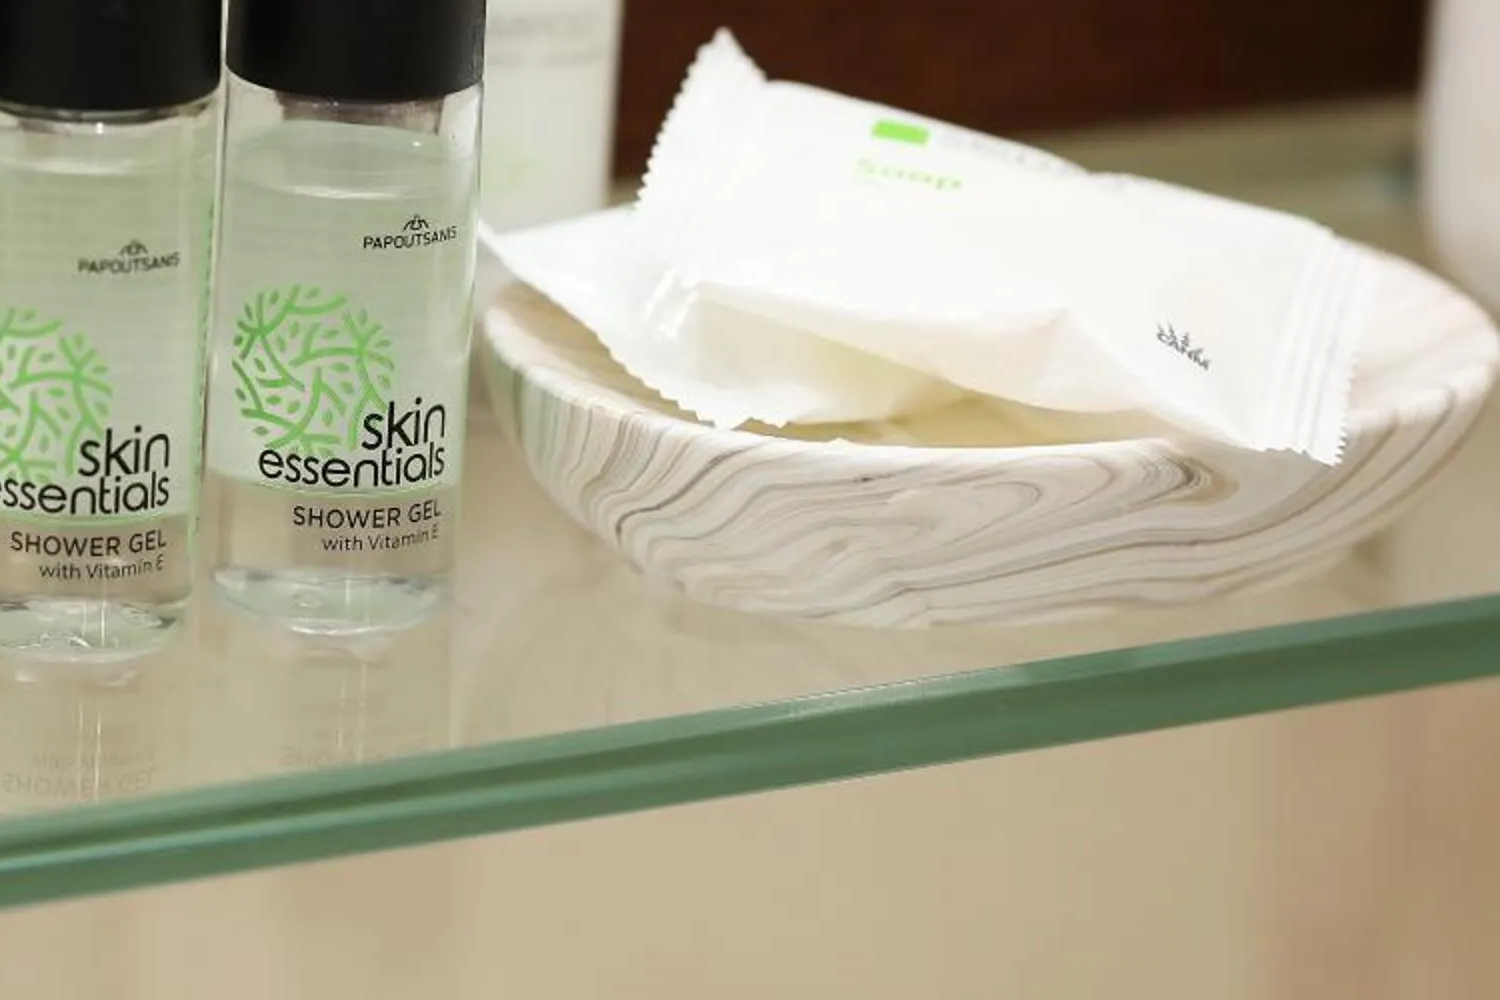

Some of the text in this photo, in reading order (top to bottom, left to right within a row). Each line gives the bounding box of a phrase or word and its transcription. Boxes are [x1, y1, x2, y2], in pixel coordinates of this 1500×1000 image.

[363, 225, 457, 249] PAPOUTSANIS
[361, 396, 446, 450] skin
[78, 425, 170, 477] skin
[258, 441, 445, 488] essentials
[292, 499, 442, 529] SHOWER GEL
[10, 528, 167, 558] SHOWER GEL
[322, 534, 363, 551] with
[367, 529, 430, 551] Vitamin
[38, 562, 81, 580] with
[85, 559, 153, 580] Vitamin
